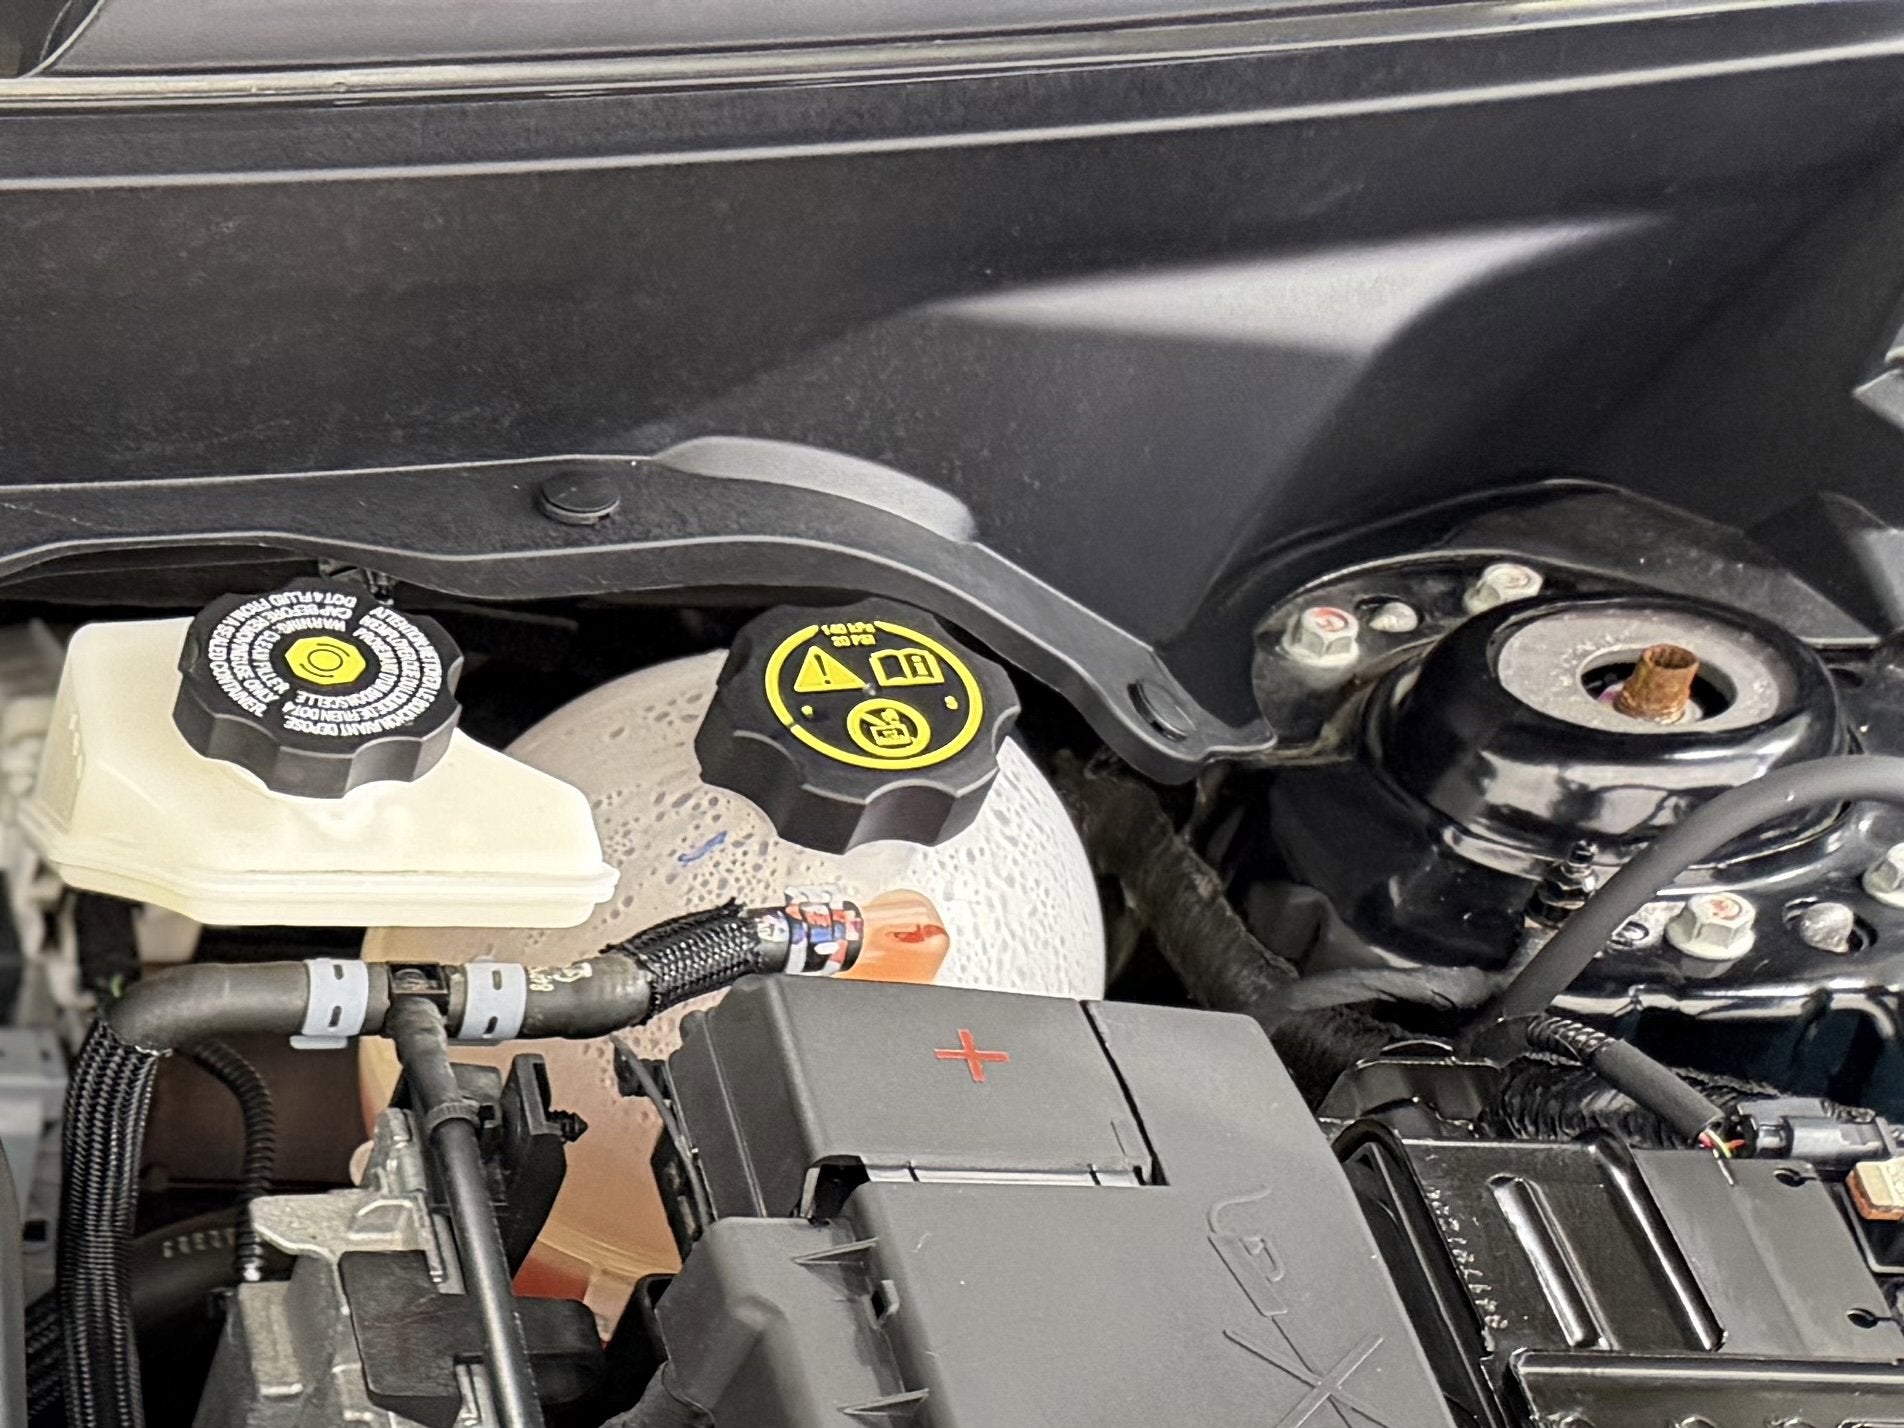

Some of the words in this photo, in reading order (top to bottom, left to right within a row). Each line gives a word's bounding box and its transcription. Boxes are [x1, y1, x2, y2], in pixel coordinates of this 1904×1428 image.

[268, 591, 313, 606] FLUID
[313, 592, 324, 605] 4
[323, 592, 357, 608] DOT
[238, 598, 267, 617] FROM
[263, 604, 320, 621] BEFORE
[319, 607, 353, 620] CAP
[225, 615, 240, 627] A
[207, 620, 236, 661] SEALED
[252, 628, 282, 660] CLEAN
[231, 659, 254, 681] USE
[252, 661, 291, 695] FILLER
[243, 679, 281, 704] ONLY
[395, 675, 420, 691] DU
[413, 686, 439, 702] LE
[354, 704, 381, 721] DE
[338, 717, 385, 738] AVANT
